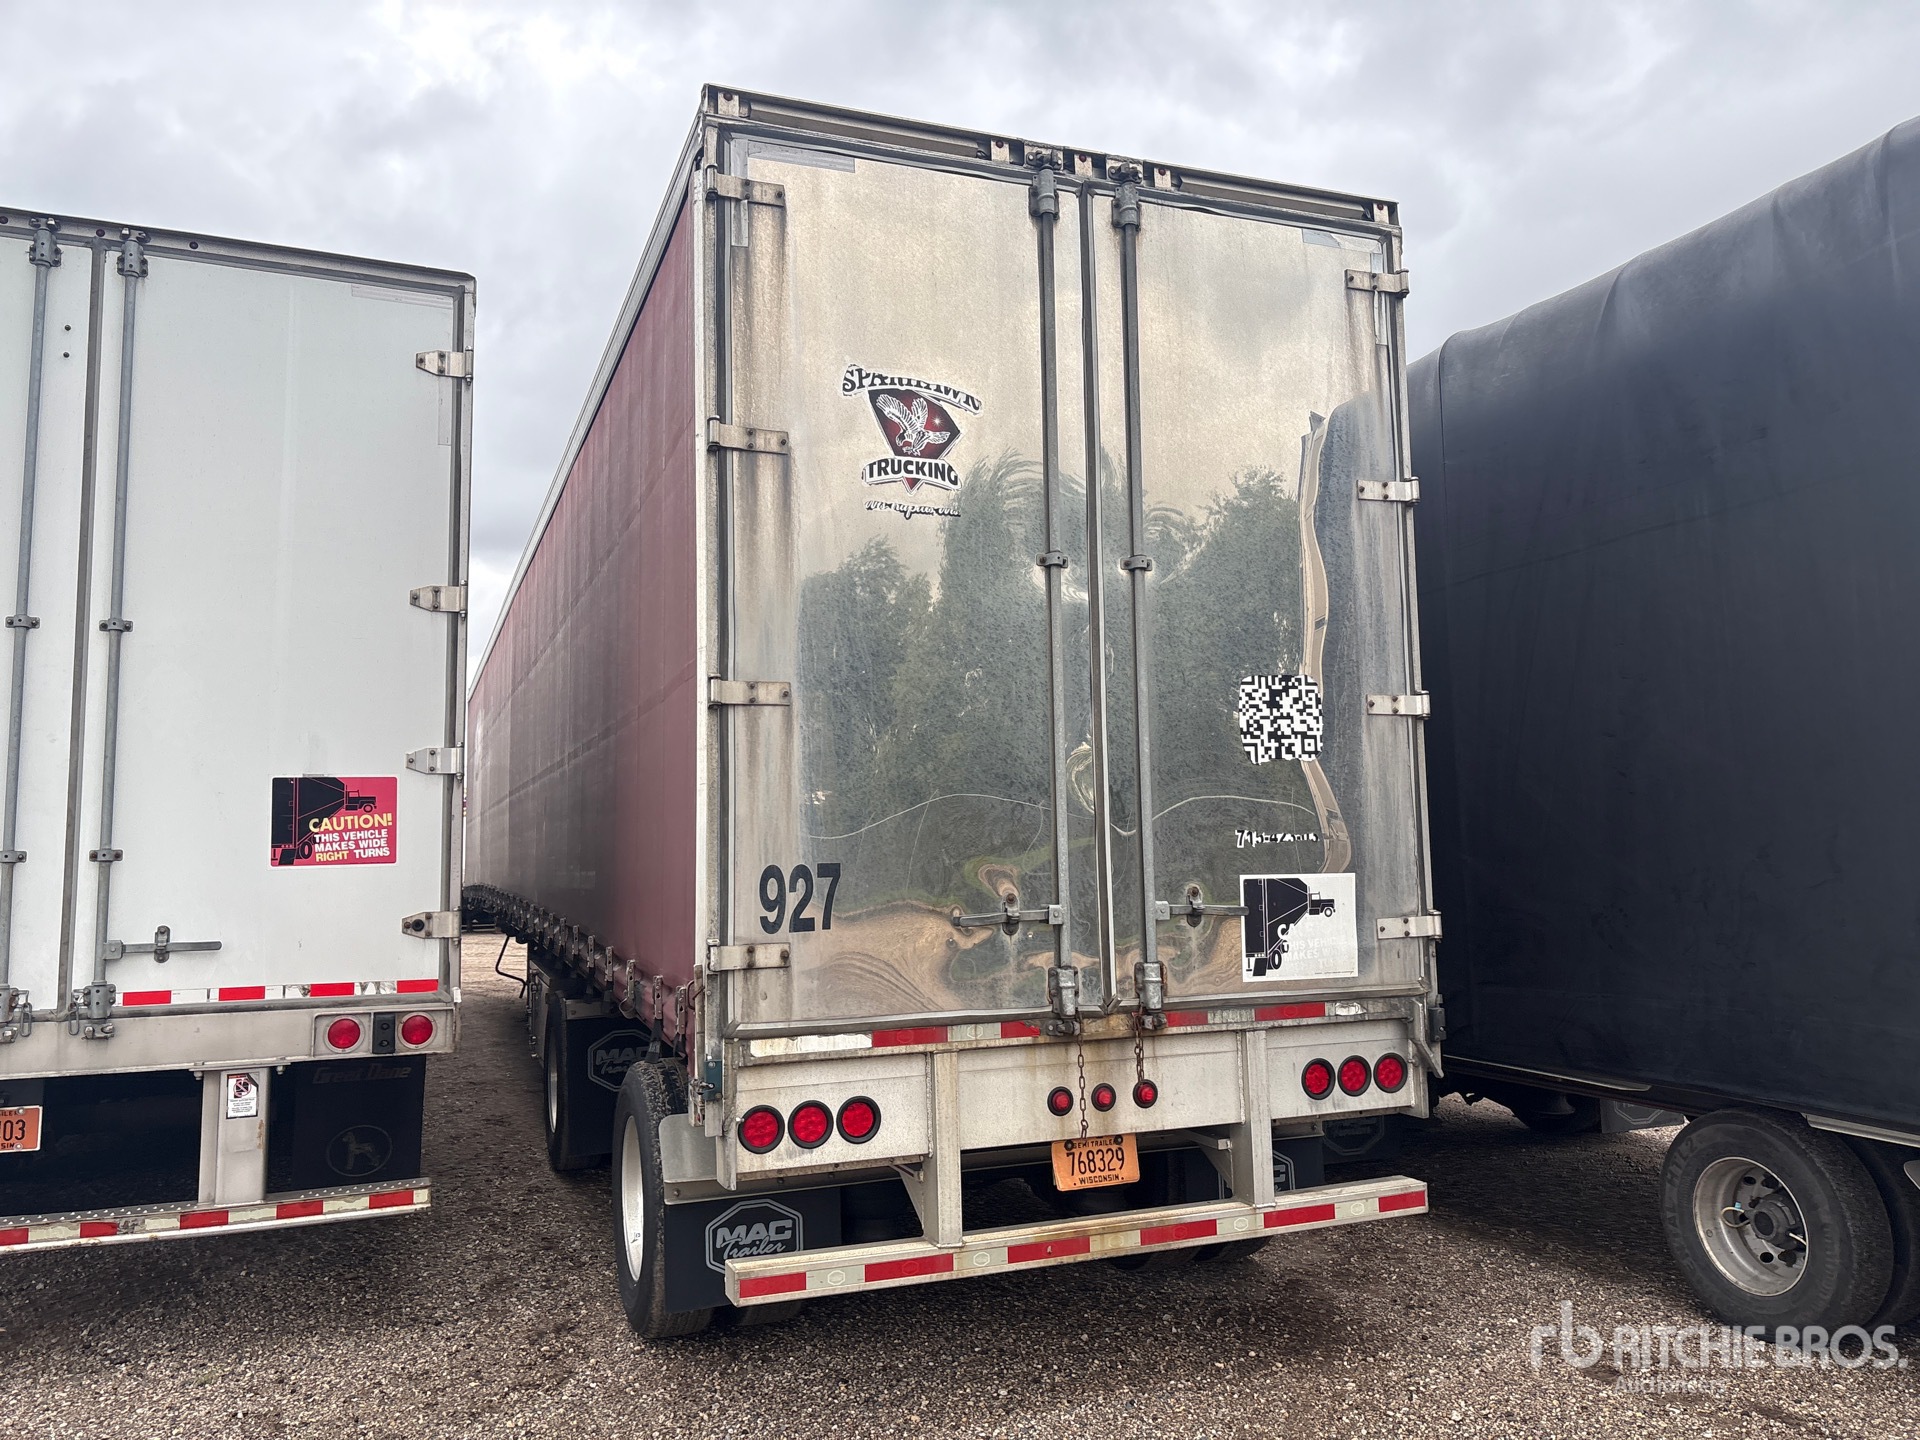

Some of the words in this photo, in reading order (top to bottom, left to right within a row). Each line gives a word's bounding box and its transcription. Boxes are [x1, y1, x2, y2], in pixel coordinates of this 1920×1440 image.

[868, 458, 959, 486] TRUCKING
[309, 813, 393, 833] CAUTION!
[314, 832, 340, 843] THIS
[342, 829, 388, 841] VEHICLE
[314, 841, 355, 853] MAKES
[359, 838, 387, 849] WIDE
[315, 851, 349, 862] RIGHT
[354, 847, 390, 858] TURNS
[759, 863, 841, 934] 927
[0, 1119, 26, 1141] 03
[1066, 1147, 1125, 1176] 768329
[1079, 1174, 1120, 1185] WISCONSIN
[716, 1219, 792, 1248] MAC
[721, 1235, 786, 1259] Trailer
